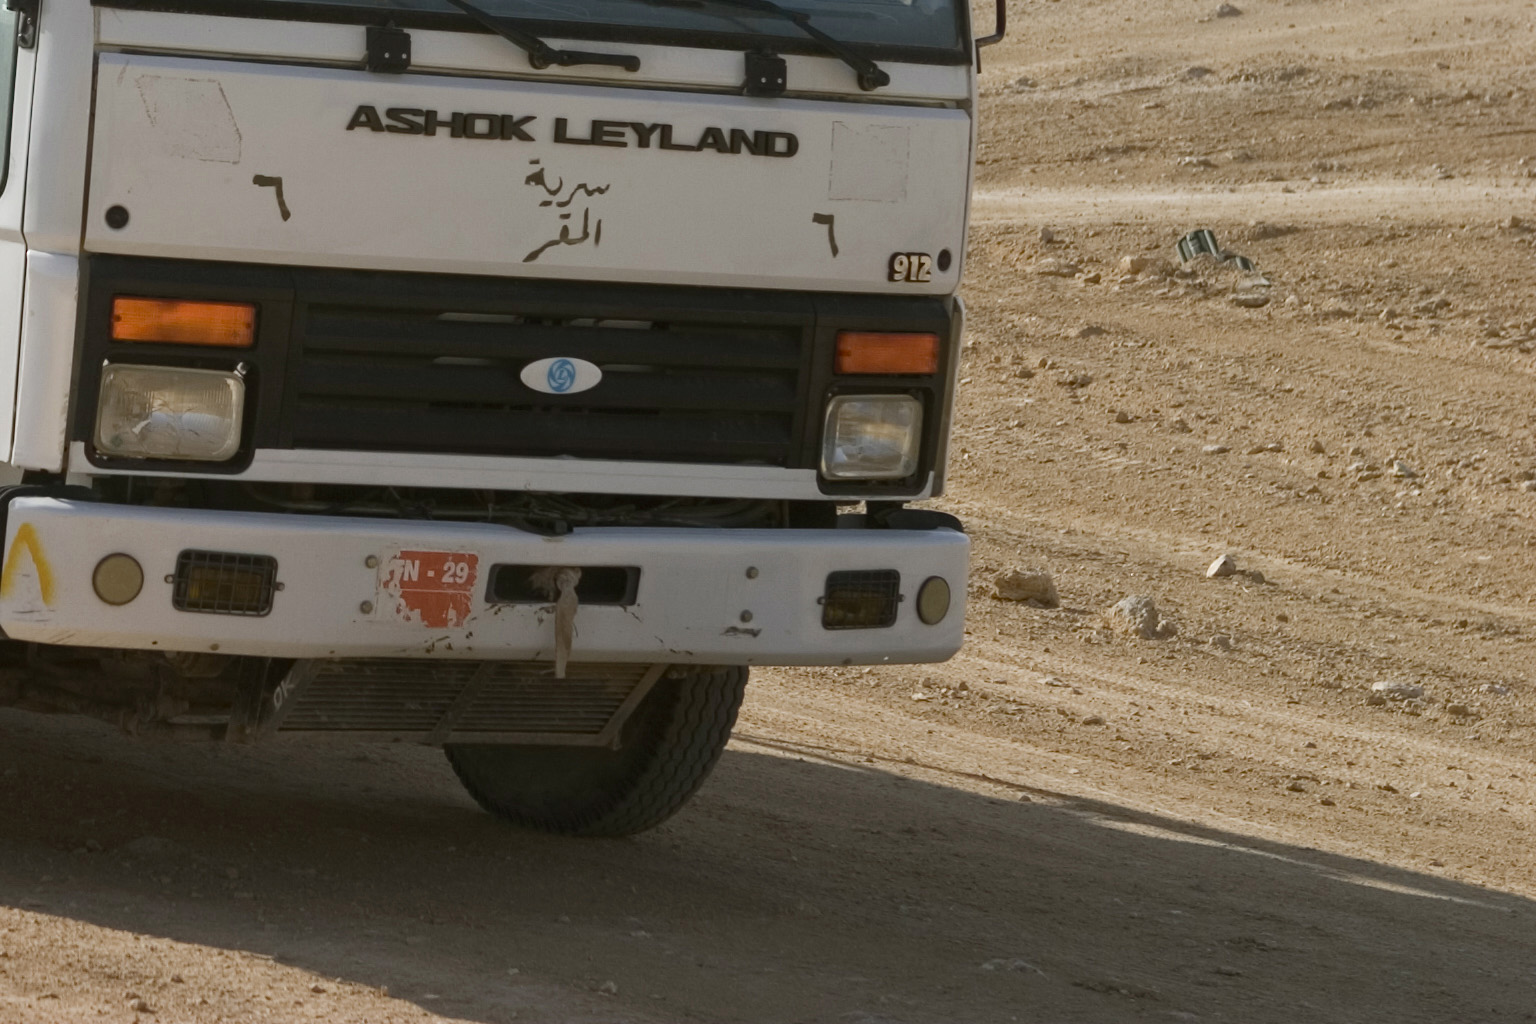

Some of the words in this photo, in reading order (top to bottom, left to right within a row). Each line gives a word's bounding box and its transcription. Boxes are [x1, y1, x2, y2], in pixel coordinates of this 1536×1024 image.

[346, 104, 537, 142] ASHOK
[553, 118, 799, 158] LEYLAND
[889, 253, 932, 282] 912
[441, 560, 470, 584] 29
